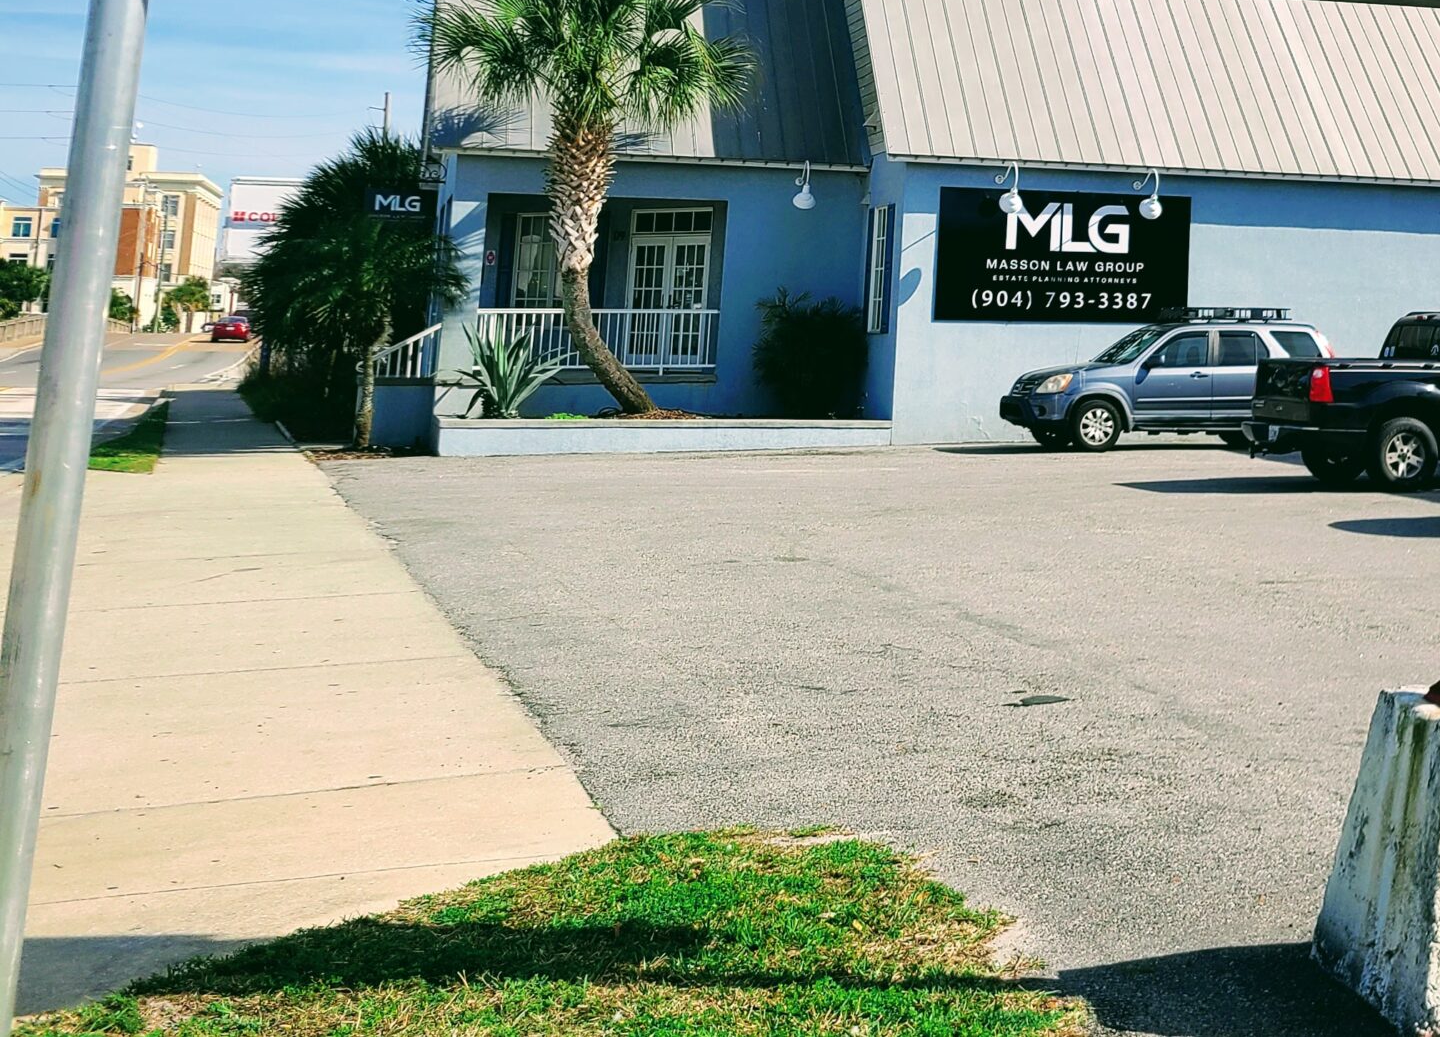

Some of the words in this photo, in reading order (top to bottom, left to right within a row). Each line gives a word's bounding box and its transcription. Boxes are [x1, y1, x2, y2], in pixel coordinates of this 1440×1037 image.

[374, 194, 421, 212] MLG
[1004, 201, 1131, 254] MLG
[985, 258, 1051, 271] MASSON
[1056, 260, 1089, 272] LAW
[1094, 262, 1145, 273] GROUP
[1032, 275, 1080, 283] PLANNING
[971, 288, 1033, 310] (904)
[1045, 291, 1152, 310] 793-3387
